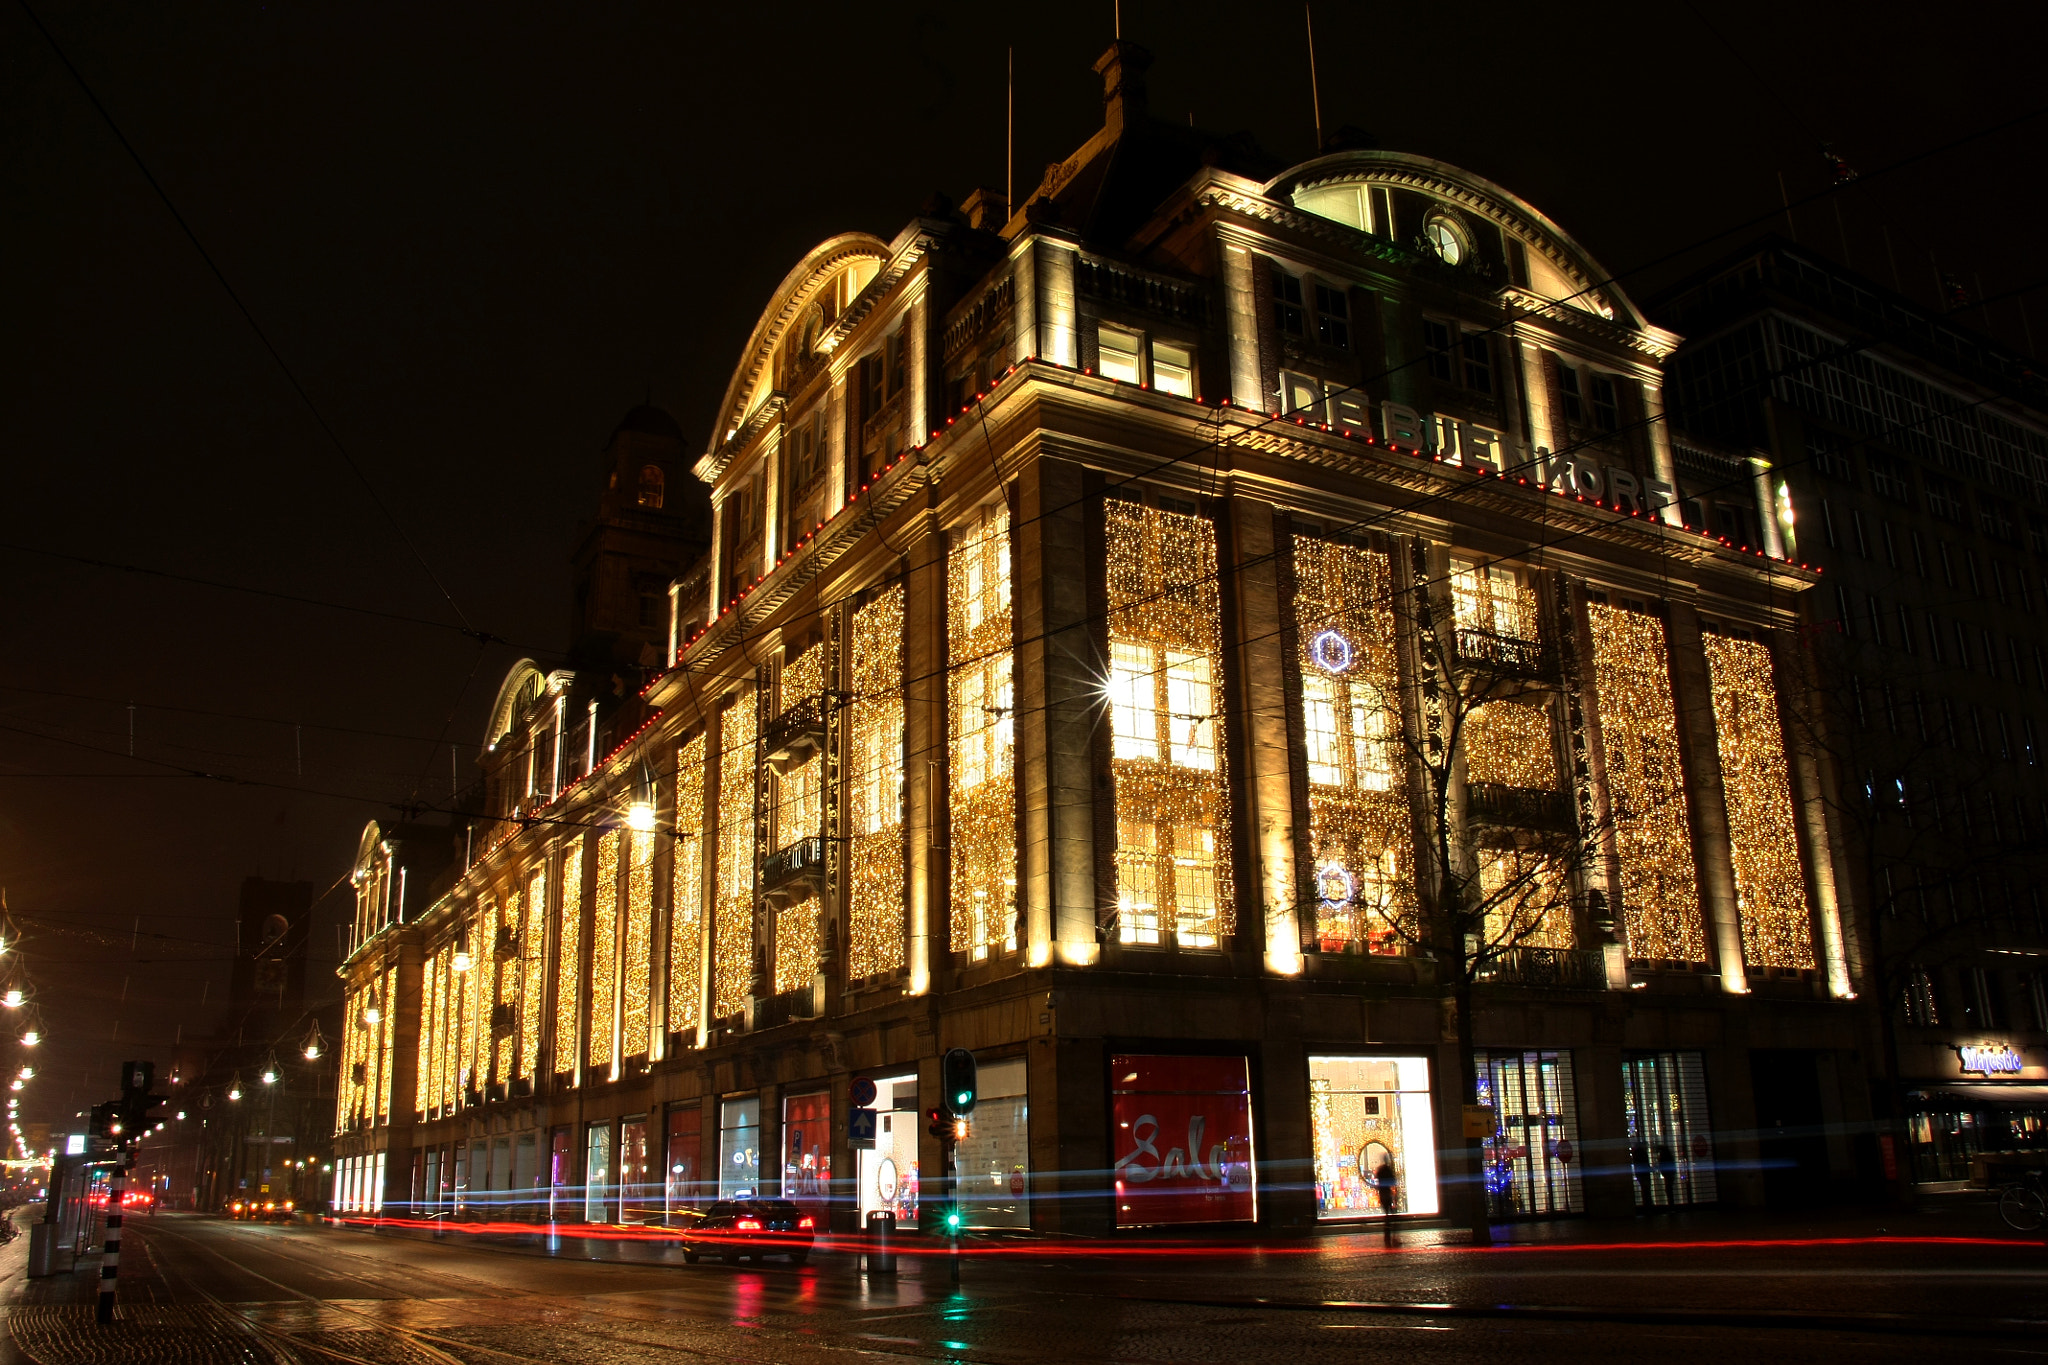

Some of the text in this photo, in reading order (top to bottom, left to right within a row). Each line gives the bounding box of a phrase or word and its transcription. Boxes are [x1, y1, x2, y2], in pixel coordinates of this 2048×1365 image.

[1279, 367, 1674, 524] DE BIJENKORF
[1960, 1046, 2023, 1076] Majestic
